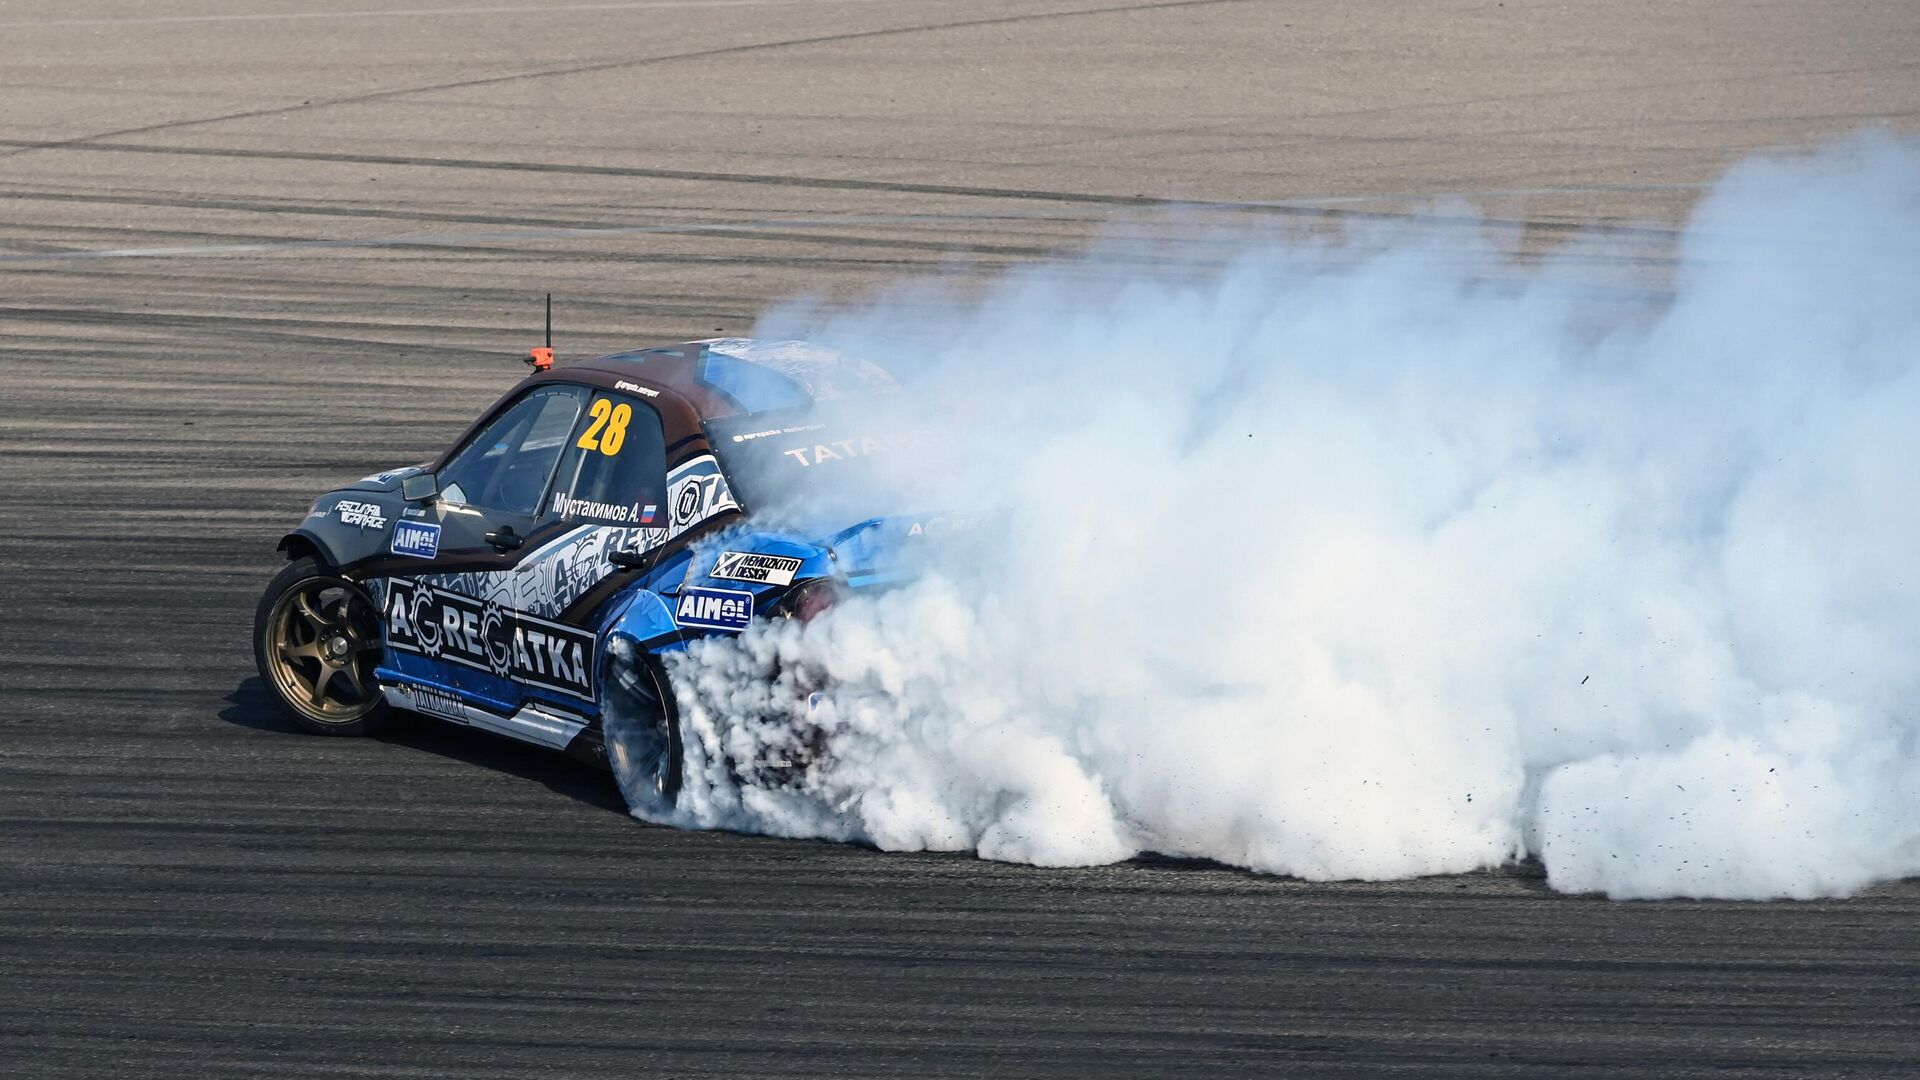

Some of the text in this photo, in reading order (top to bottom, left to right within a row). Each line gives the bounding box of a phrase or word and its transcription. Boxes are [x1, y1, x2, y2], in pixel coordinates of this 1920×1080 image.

[576, 398, 632, 456] 28
[552, 492, 640, 523] Мустакимов А.
[394, 527, 436, 551] AIMOL
[734, 566, 771, 581] DESIGN
[678, 595, 749, 622] AIMOL
[391, 580, 589, 688] AGREGATKA
